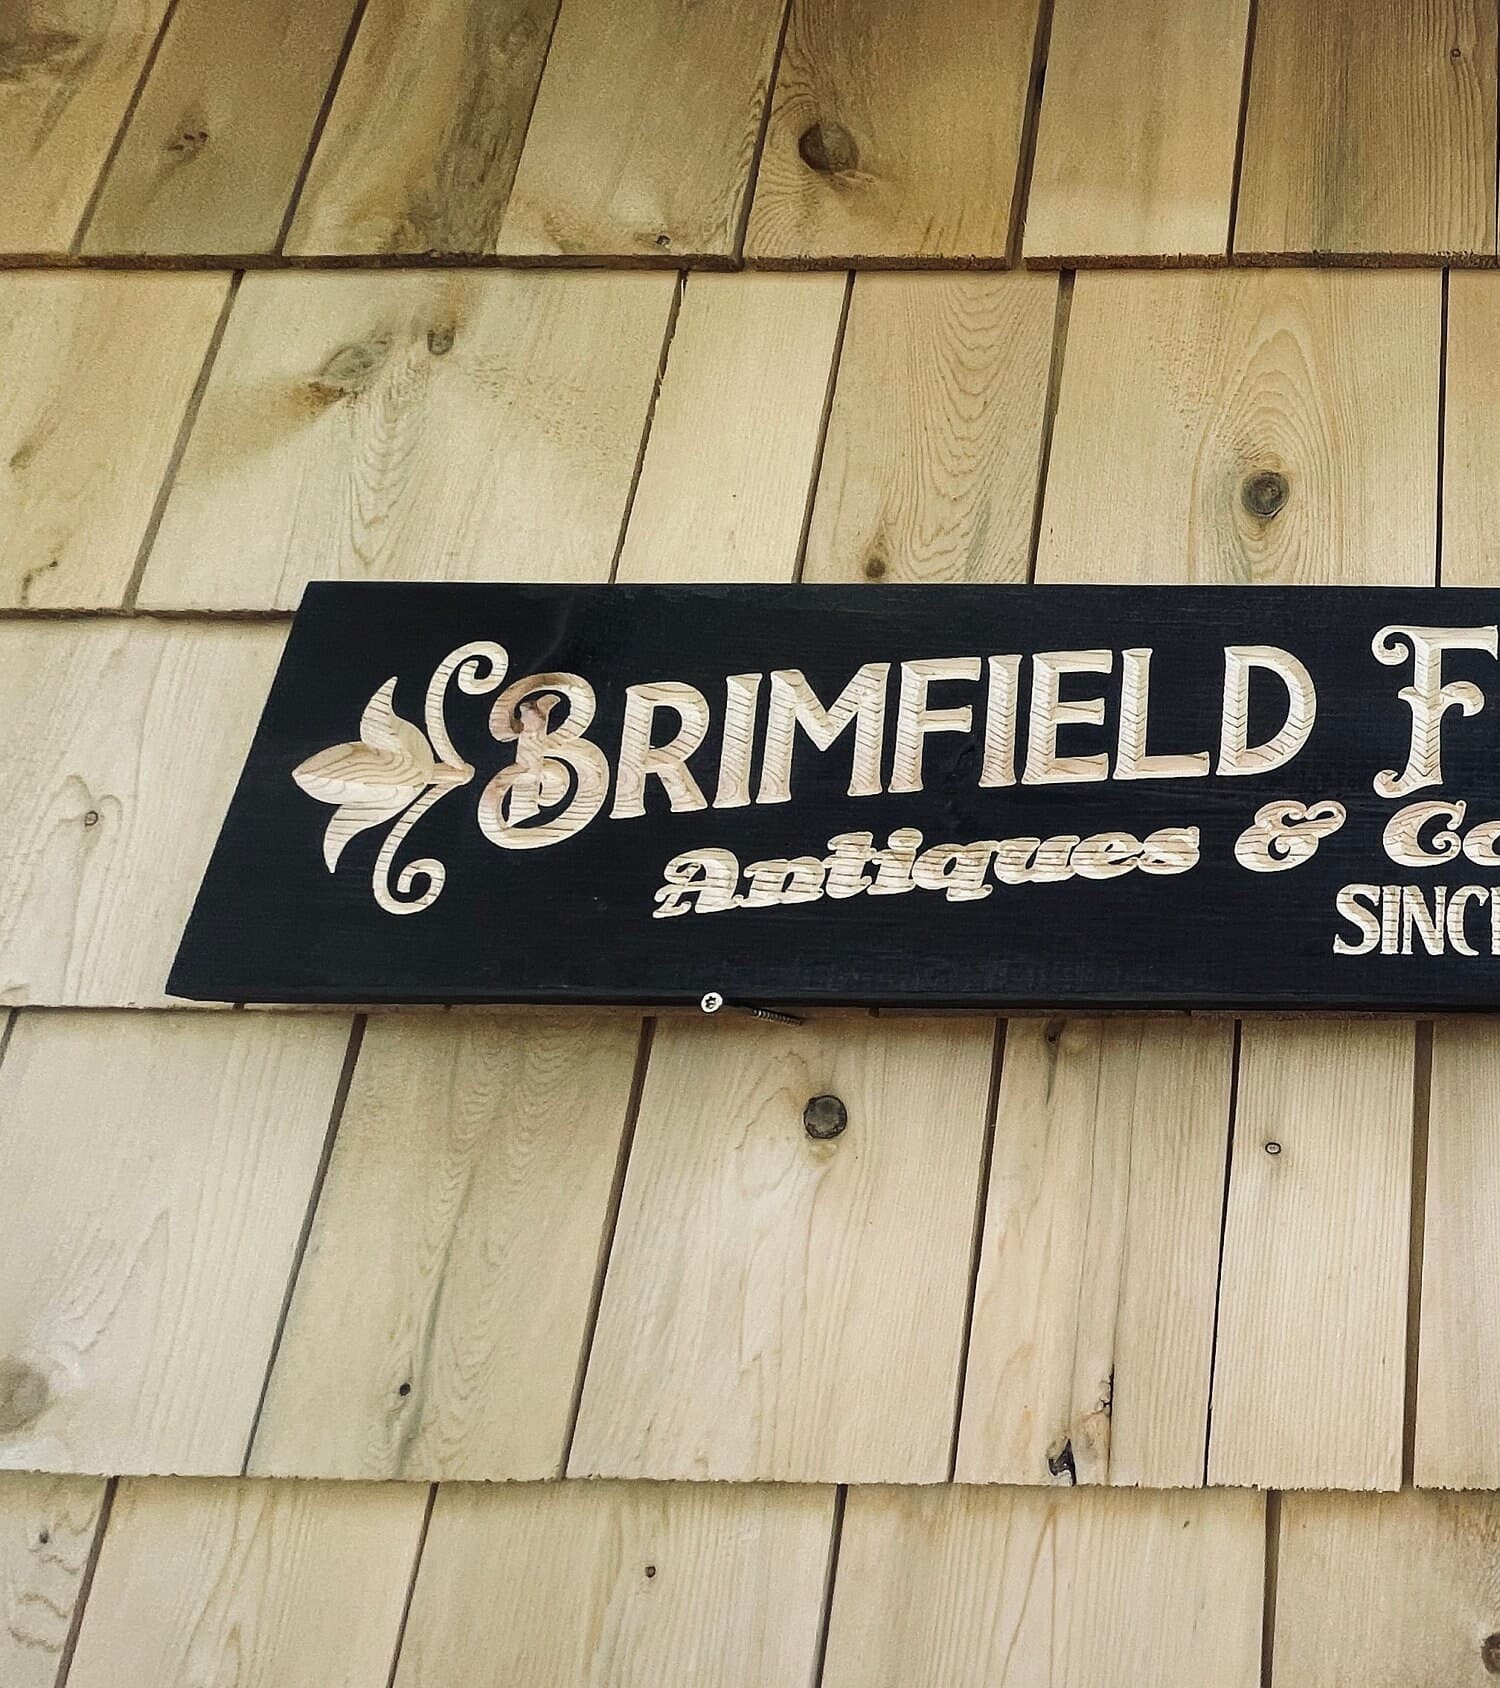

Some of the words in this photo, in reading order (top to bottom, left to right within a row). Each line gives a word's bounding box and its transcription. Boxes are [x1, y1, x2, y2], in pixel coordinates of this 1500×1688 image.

[478, 645, 1316, 849] BRIMFIELD
[653, 826, 1200, 918] Antiques
[1234, 800, 1346, 872] &
